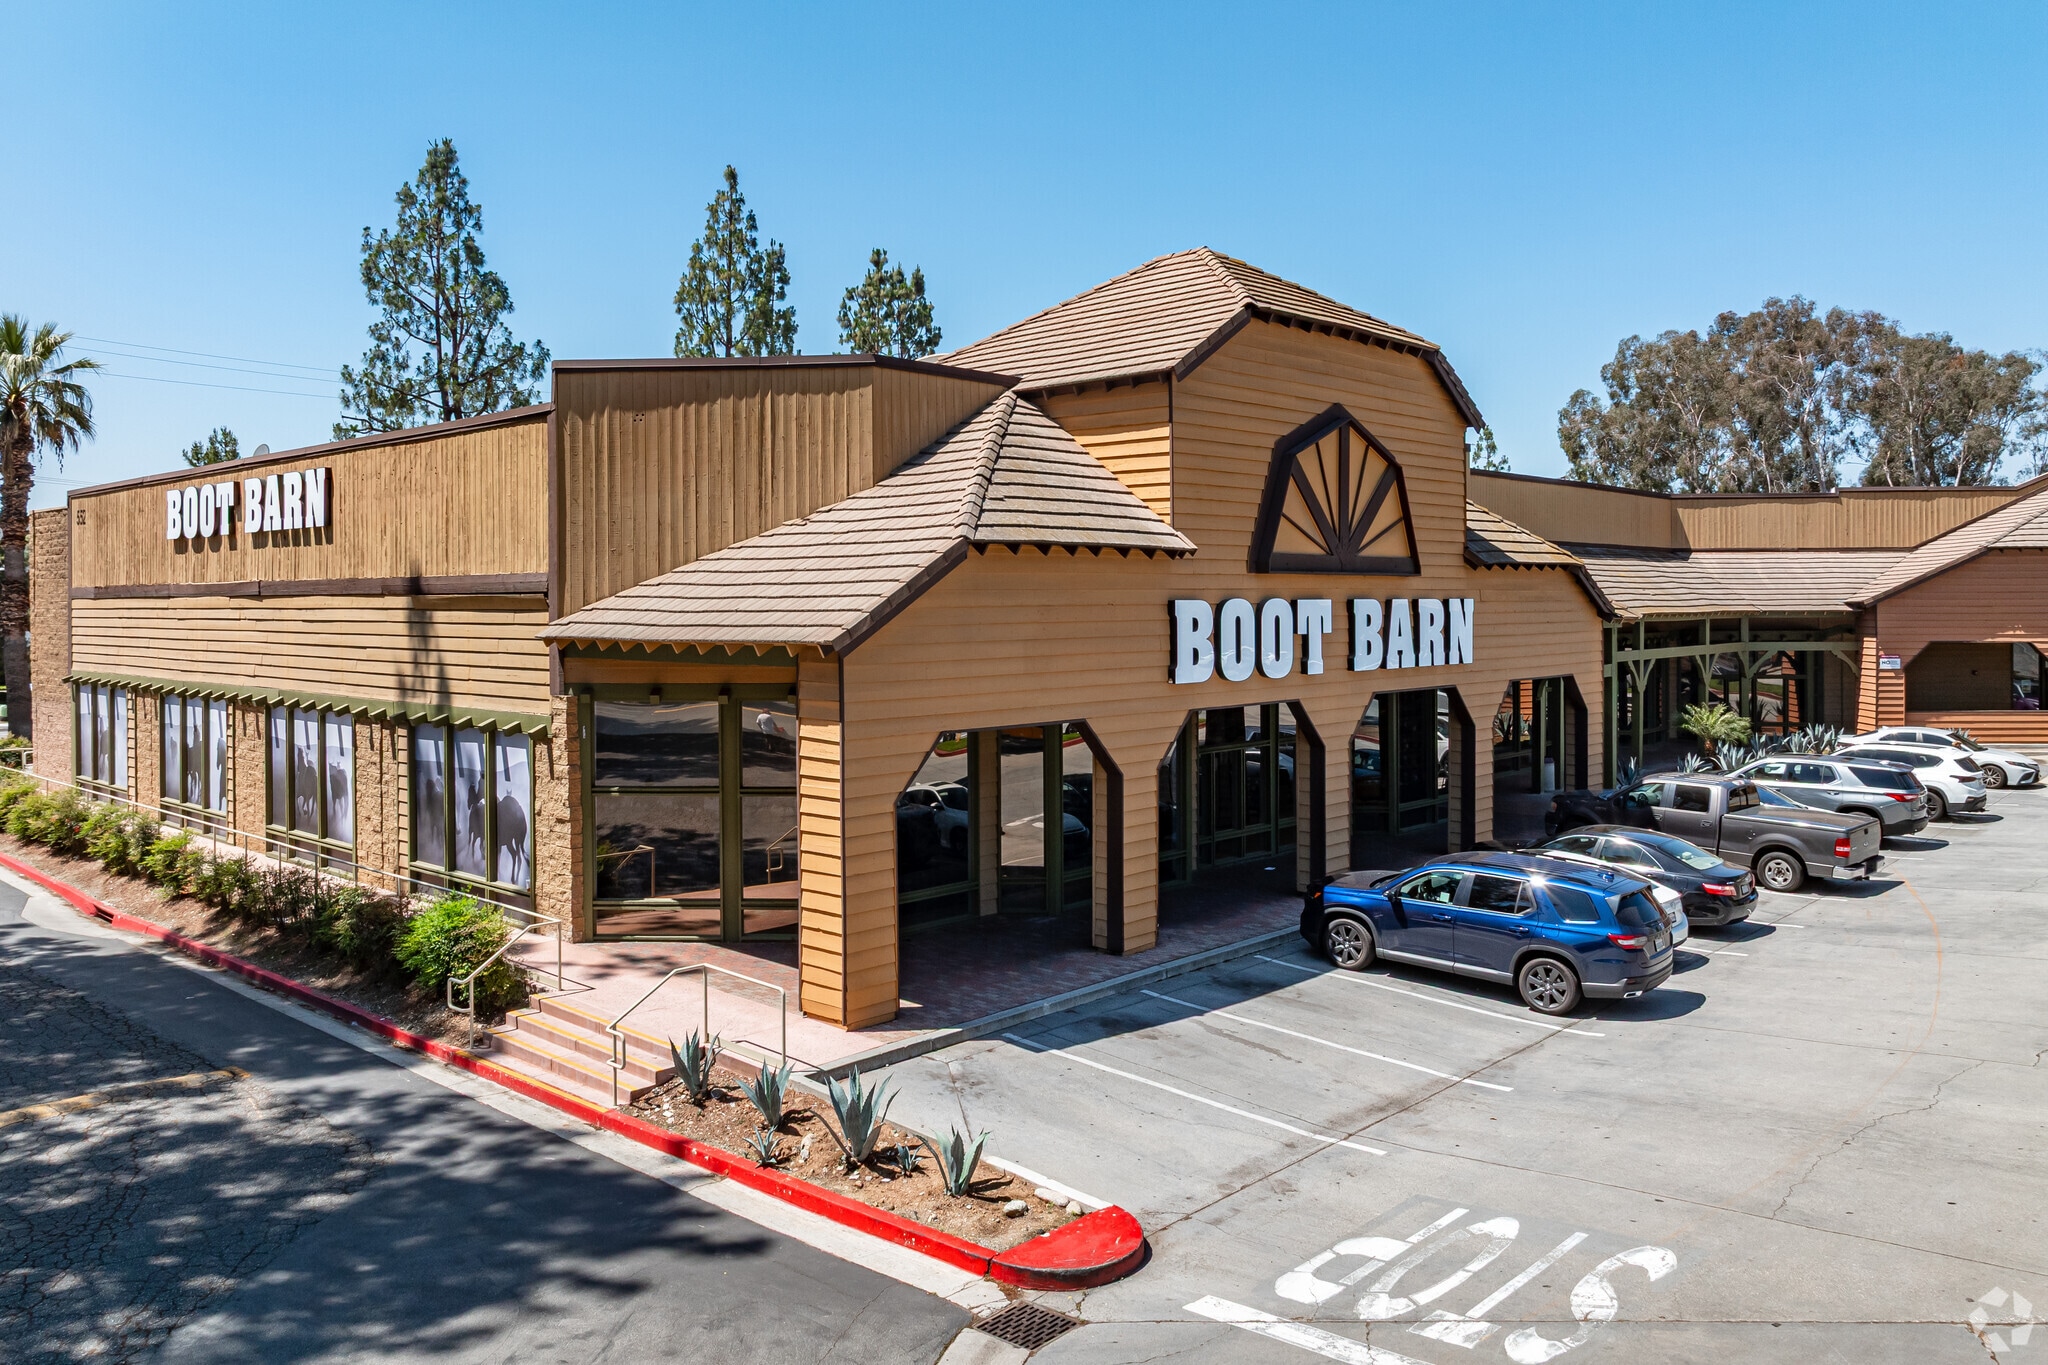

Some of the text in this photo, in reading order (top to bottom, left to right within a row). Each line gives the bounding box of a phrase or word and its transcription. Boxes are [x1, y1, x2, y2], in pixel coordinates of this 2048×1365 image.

[166, 467, 329, 540] BOOT BARN
[1171, 597, 1475, 684] BOOT BARN
